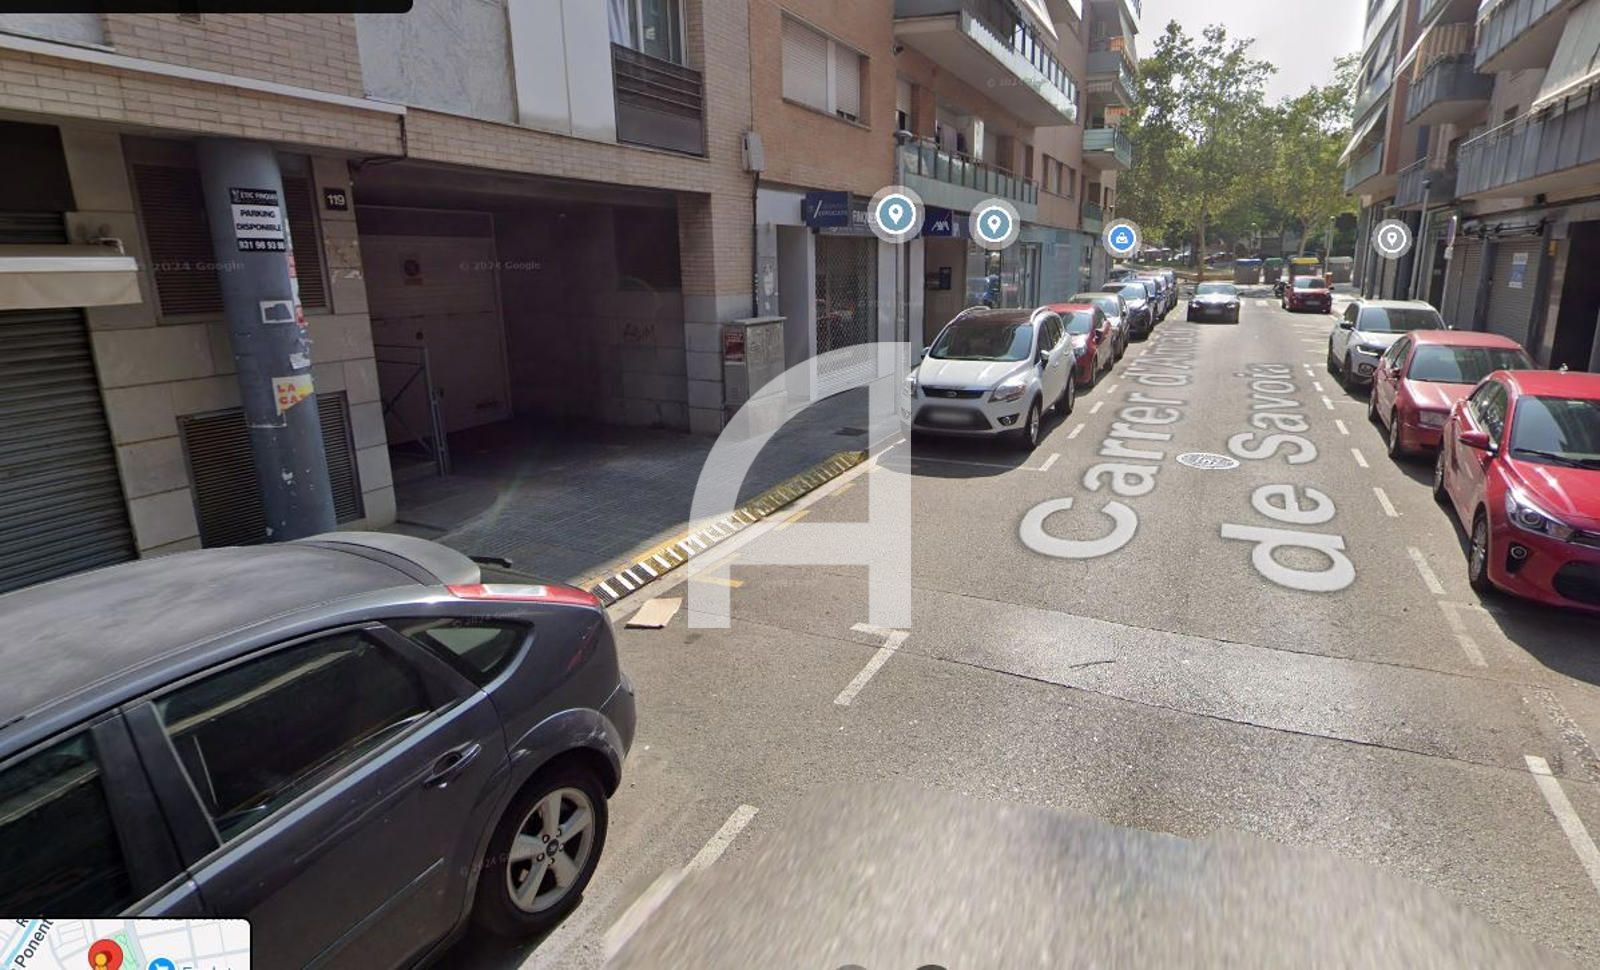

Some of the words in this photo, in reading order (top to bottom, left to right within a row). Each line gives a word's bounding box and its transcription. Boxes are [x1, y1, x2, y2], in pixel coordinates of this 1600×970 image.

[327, 195, 345, 205] 119
[240, 209, 276, 218] PARKING
[931, 221, 950, 231] AXA
[14, 919, 54, 968] Ponent
